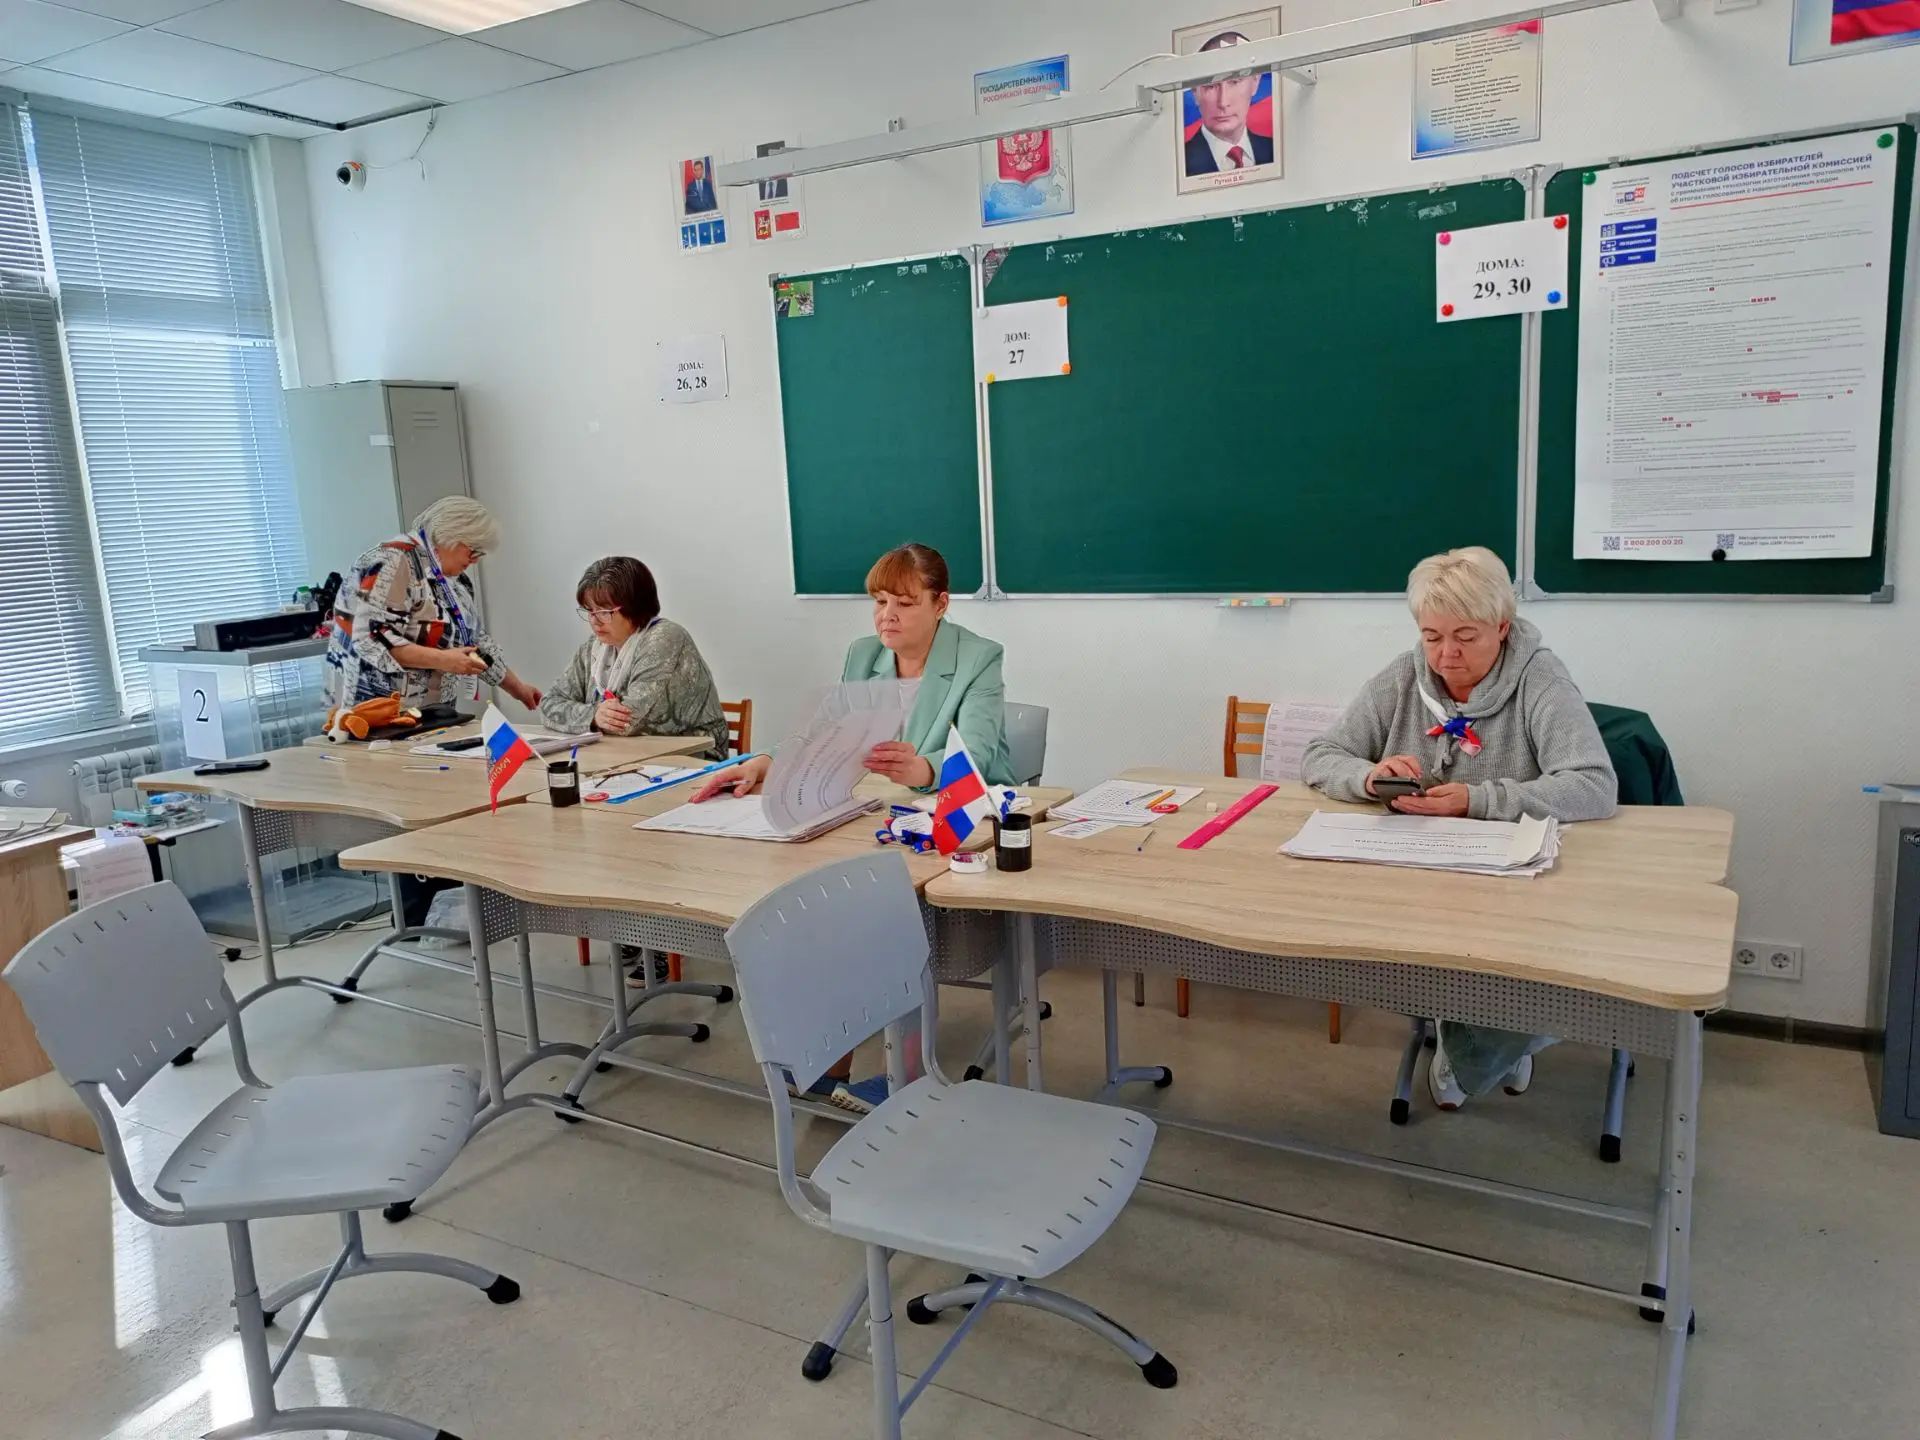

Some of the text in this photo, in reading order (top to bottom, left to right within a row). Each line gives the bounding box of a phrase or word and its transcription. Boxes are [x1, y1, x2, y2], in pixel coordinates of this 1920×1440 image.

[980, 73, 1045, 95] ГОСУДАРСТВЕННЫЙ
[983, 88, 1022, 104] РОССИЙСКОЙ
[1671, 152, 1824, 181] ПОДСЧЕТ ГОЛОСОВ ИЗБИРАТЕЛЕЙ
[1671, 154, 1873, 189] УЧАСТКОВОЙ ИЗБИРАТЕЛЬНОЙ КОМИССИЕЙ
[1475, 258, 1525, 274] ДОМА:
[1472, 277, 1531, 300] 29, 30
[1003, 331, 1031, 344] ДОМ:
[1008, 349, 1025, 365] 27
[678, 361, 704, 372] ДОМА:
[676, 376, 707, 391] 26, 28
[193, 689, 209, 723] 2
